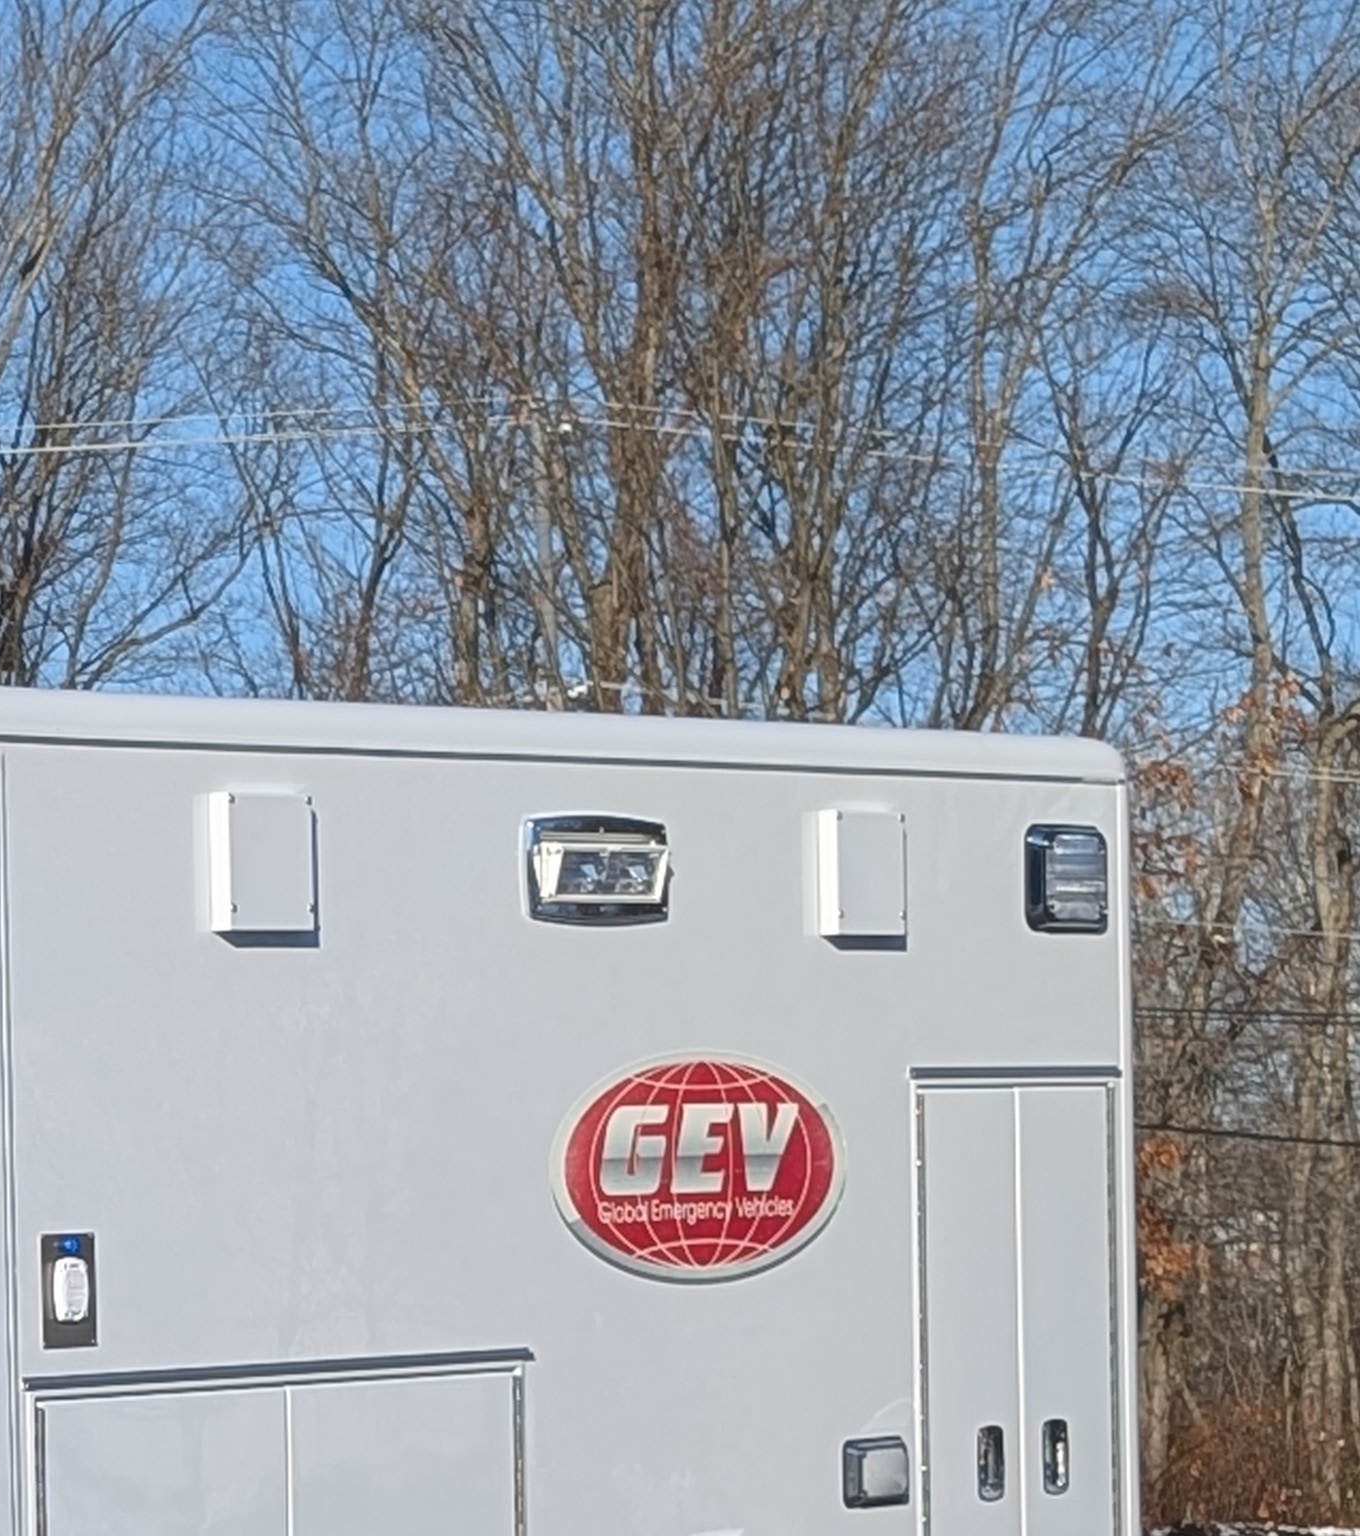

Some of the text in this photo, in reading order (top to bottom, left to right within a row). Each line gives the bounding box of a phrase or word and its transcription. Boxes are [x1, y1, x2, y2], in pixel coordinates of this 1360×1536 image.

[600, 1103, 798, 1196] GEV
[597, 1197, 794, 1225] Global Emergency Vehicles
